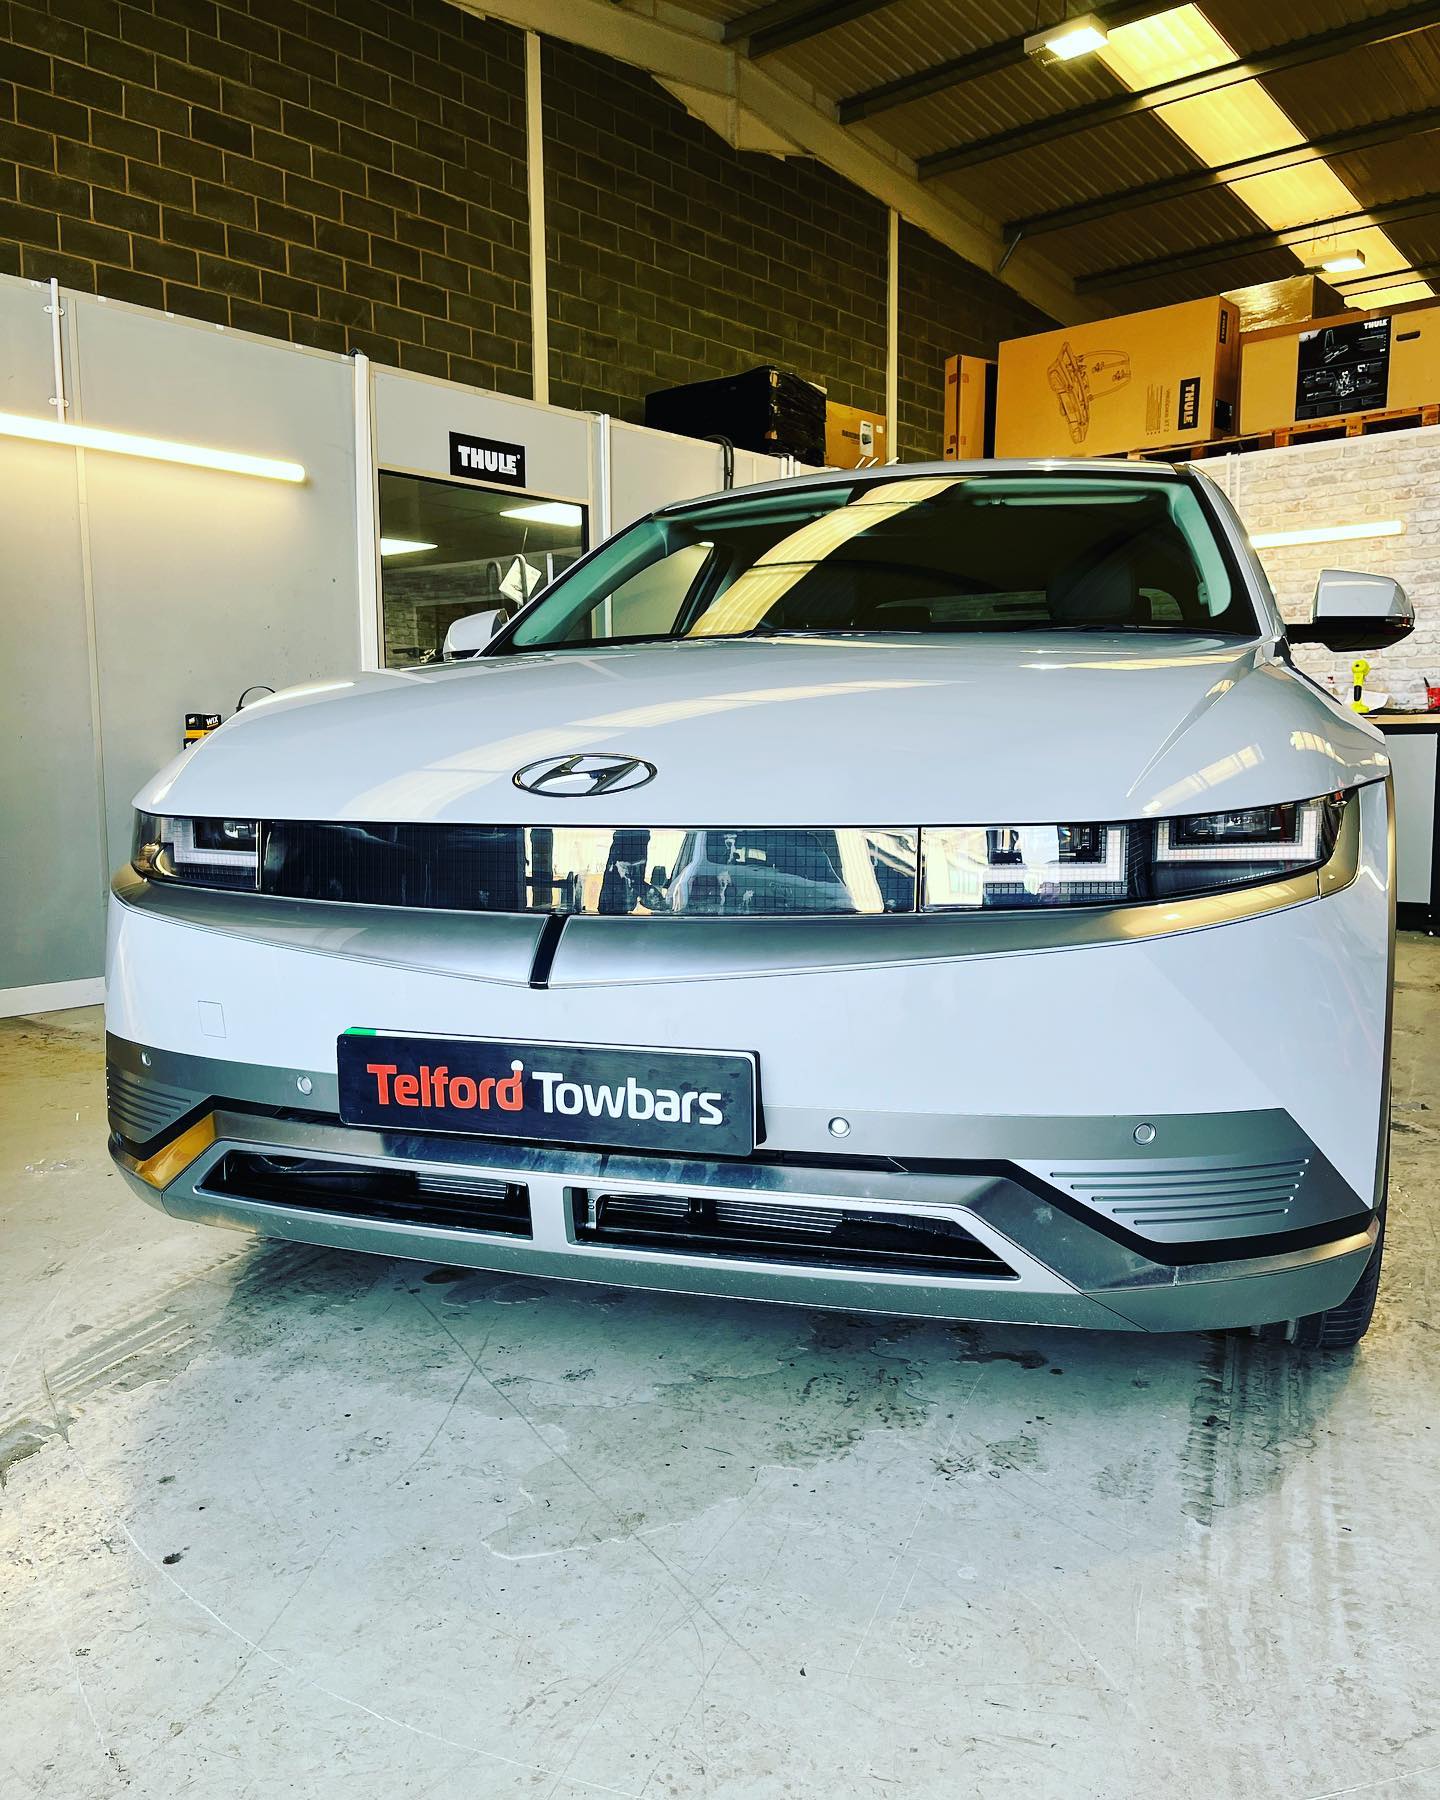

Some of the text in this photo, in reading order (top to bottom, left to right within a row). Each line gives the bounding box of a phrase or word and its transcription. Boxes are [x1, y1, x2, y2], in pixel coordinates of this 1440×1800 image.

[1363, 318, 1388, 330] THULE
[1183, 383, 1196, 425] THULE
[457, 444, 517, 476] THULE
[206, 716, 219, 726] WIX
[366, 1060, 724, 1126] Telford Towbars
